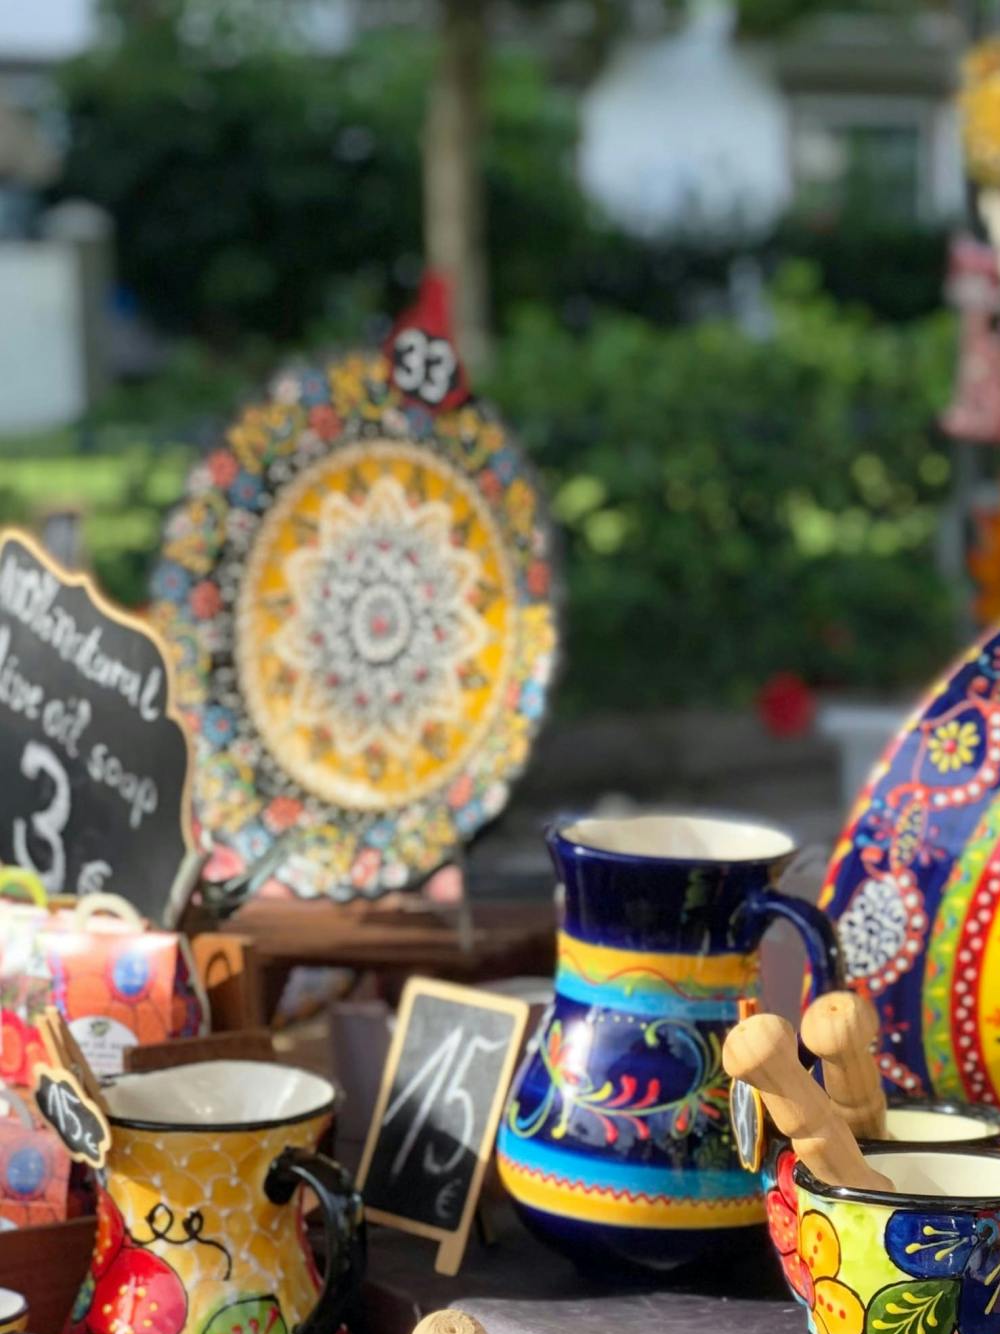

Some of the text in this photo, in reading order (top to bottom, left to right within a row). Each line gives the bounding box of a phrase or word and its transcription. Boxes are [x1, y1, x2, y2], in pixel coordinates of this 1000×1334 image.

[394, 329, 456, 404] 33
[88, 743, 158, 829] soap
[383, 1026, 508, 1180] 15
